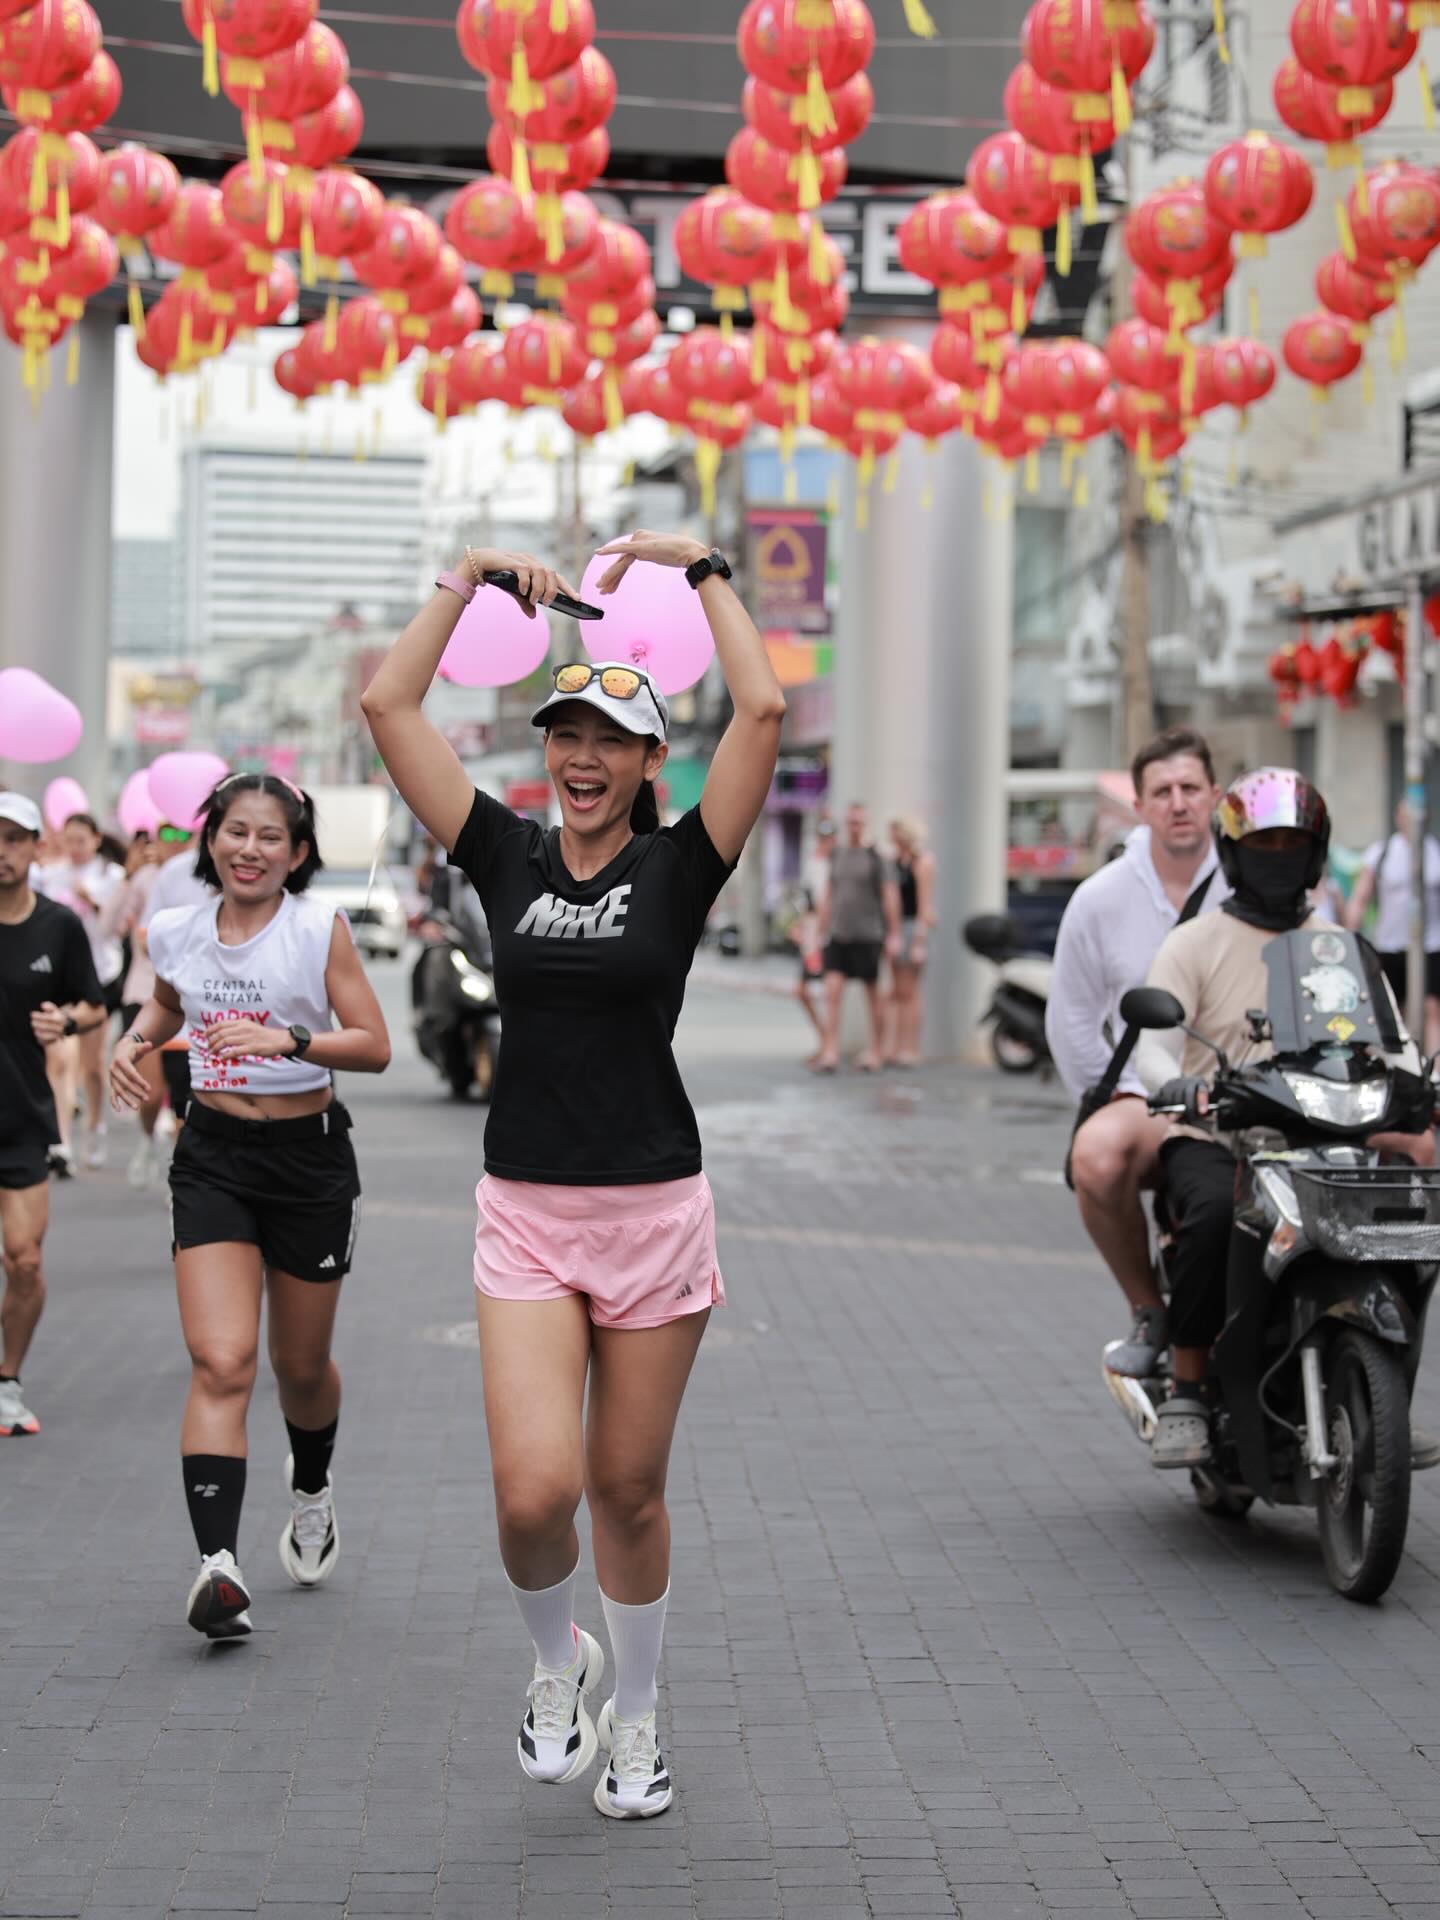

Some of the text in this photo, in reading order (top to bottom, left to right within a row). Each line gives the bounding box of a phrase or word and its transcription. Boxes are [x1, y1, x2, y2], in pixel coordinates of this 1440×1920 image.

[513, 883, 632, 939] NIKE
[203, 979, 267, 990] CENTRAL
[204, 992, 263, 1003] PATTAYA
[203, 1077, 248, 1089] MOTION
